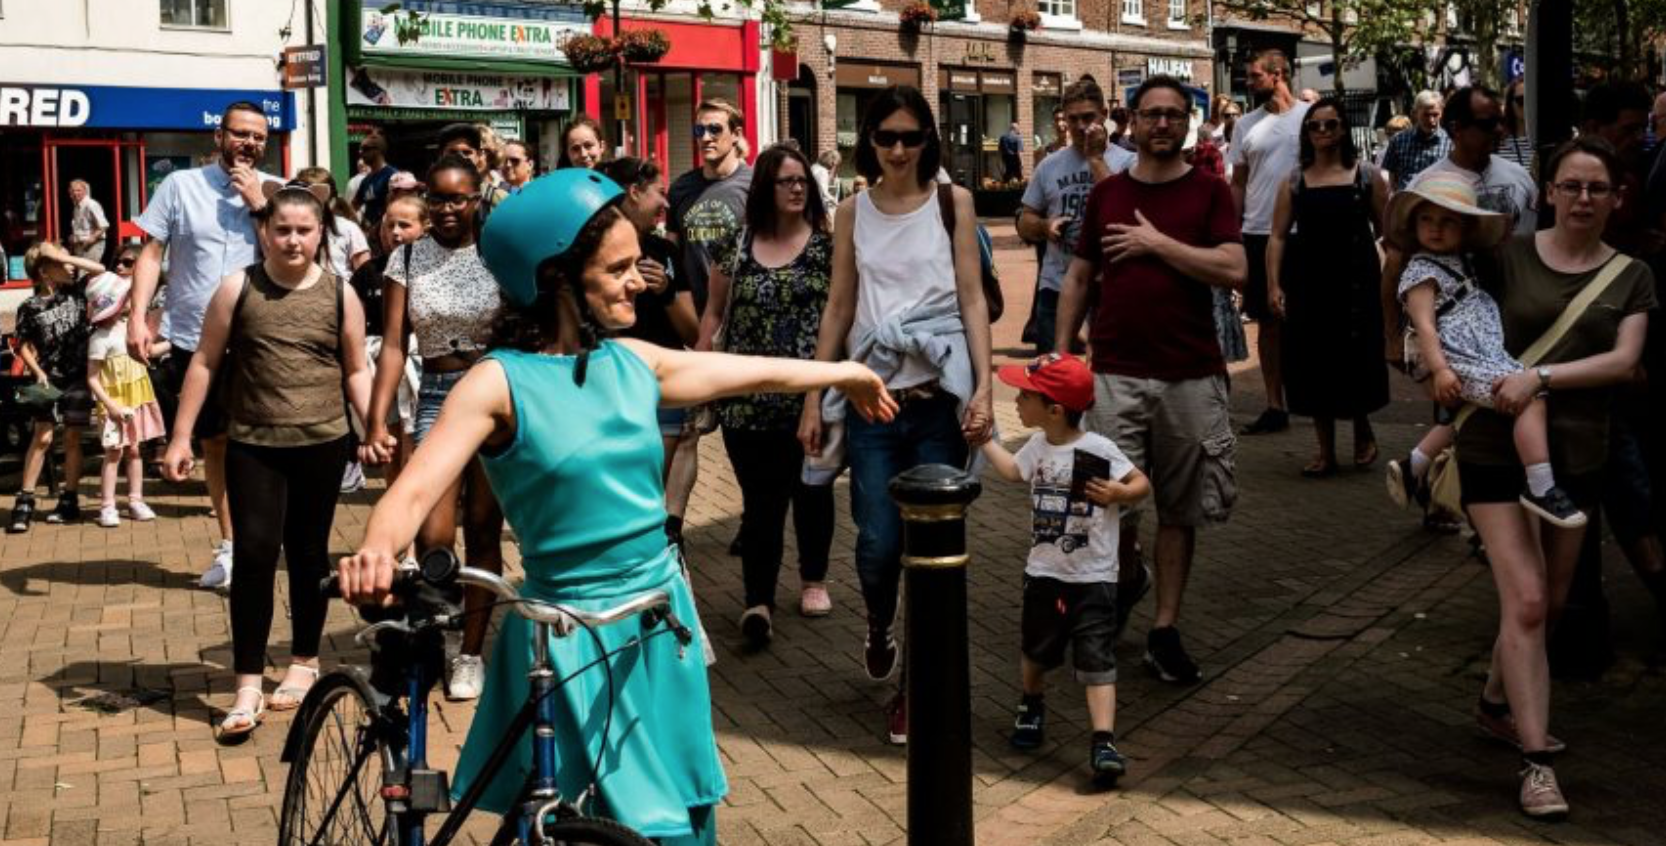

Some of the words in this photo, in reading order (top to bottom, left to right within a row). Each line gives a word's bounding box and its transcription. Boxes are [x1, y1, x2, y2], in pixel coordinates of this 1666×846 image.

[394, 15, 452, 38] MBILE
[457, 21, 506, 42] PHONE
[511, 25, 551, 44] EXTRA
[1148, 58, 1192, 77] HALIFAX
[424, 72, 462, 84] MOBILE
[466, 74, 503, 87] PHONE
[0, 87, 90, 127] RED
[263, 99, 280, 112] the
[435, 88, 483, 107] EXTRA
